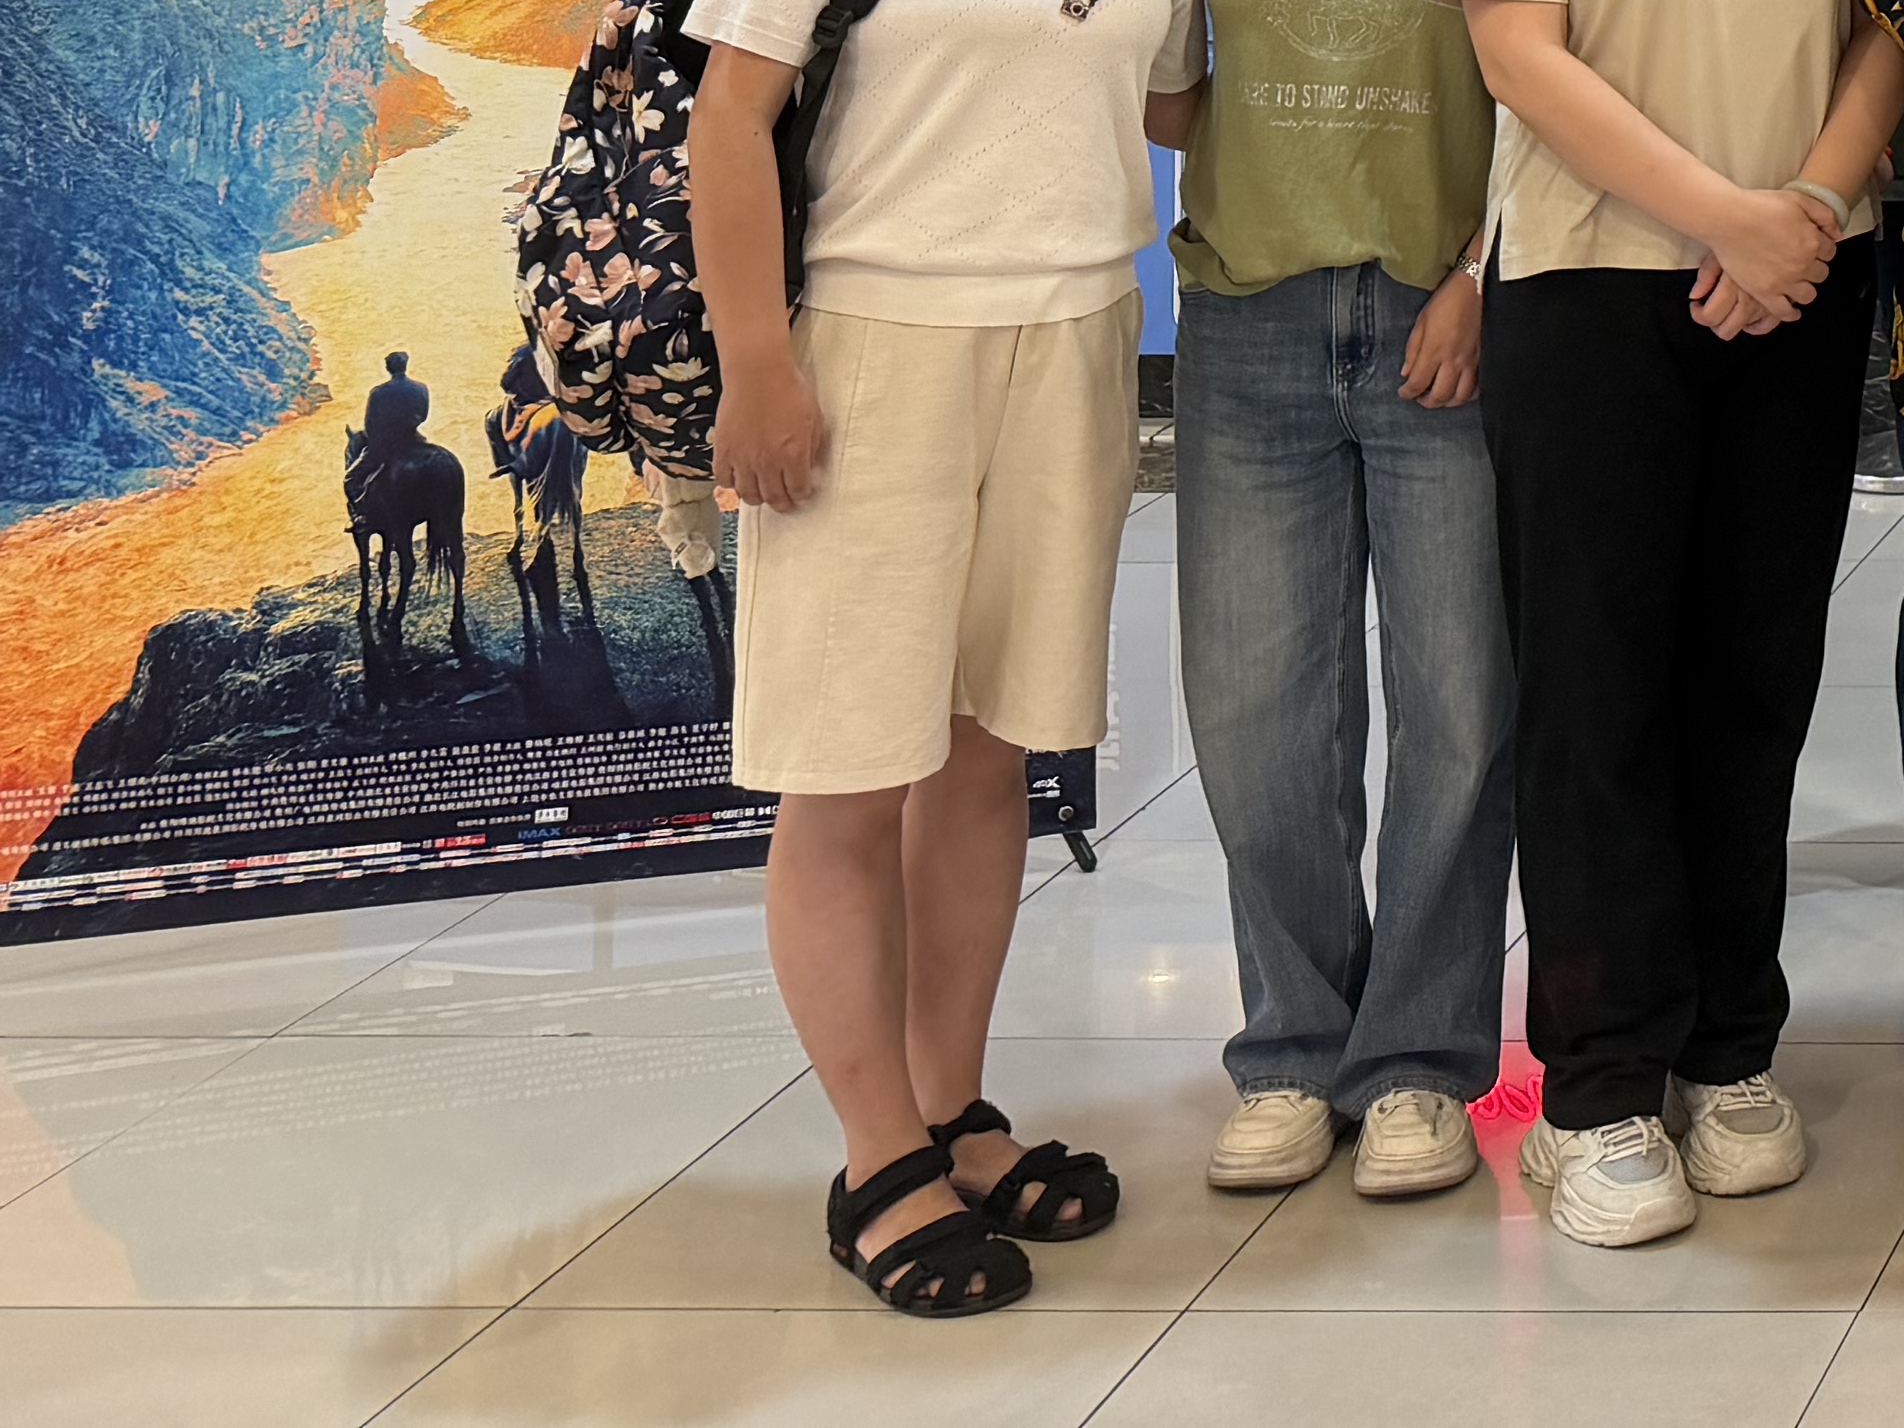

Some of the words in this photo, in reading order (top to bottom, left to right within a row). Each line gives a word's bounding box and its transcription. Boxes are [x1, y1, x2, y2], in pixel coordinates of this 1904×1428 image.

[1276, 83, 1296, 108] TO
[1302, 84, 1349, 109] STAND
[517, 827, 561, 840] IMAX
